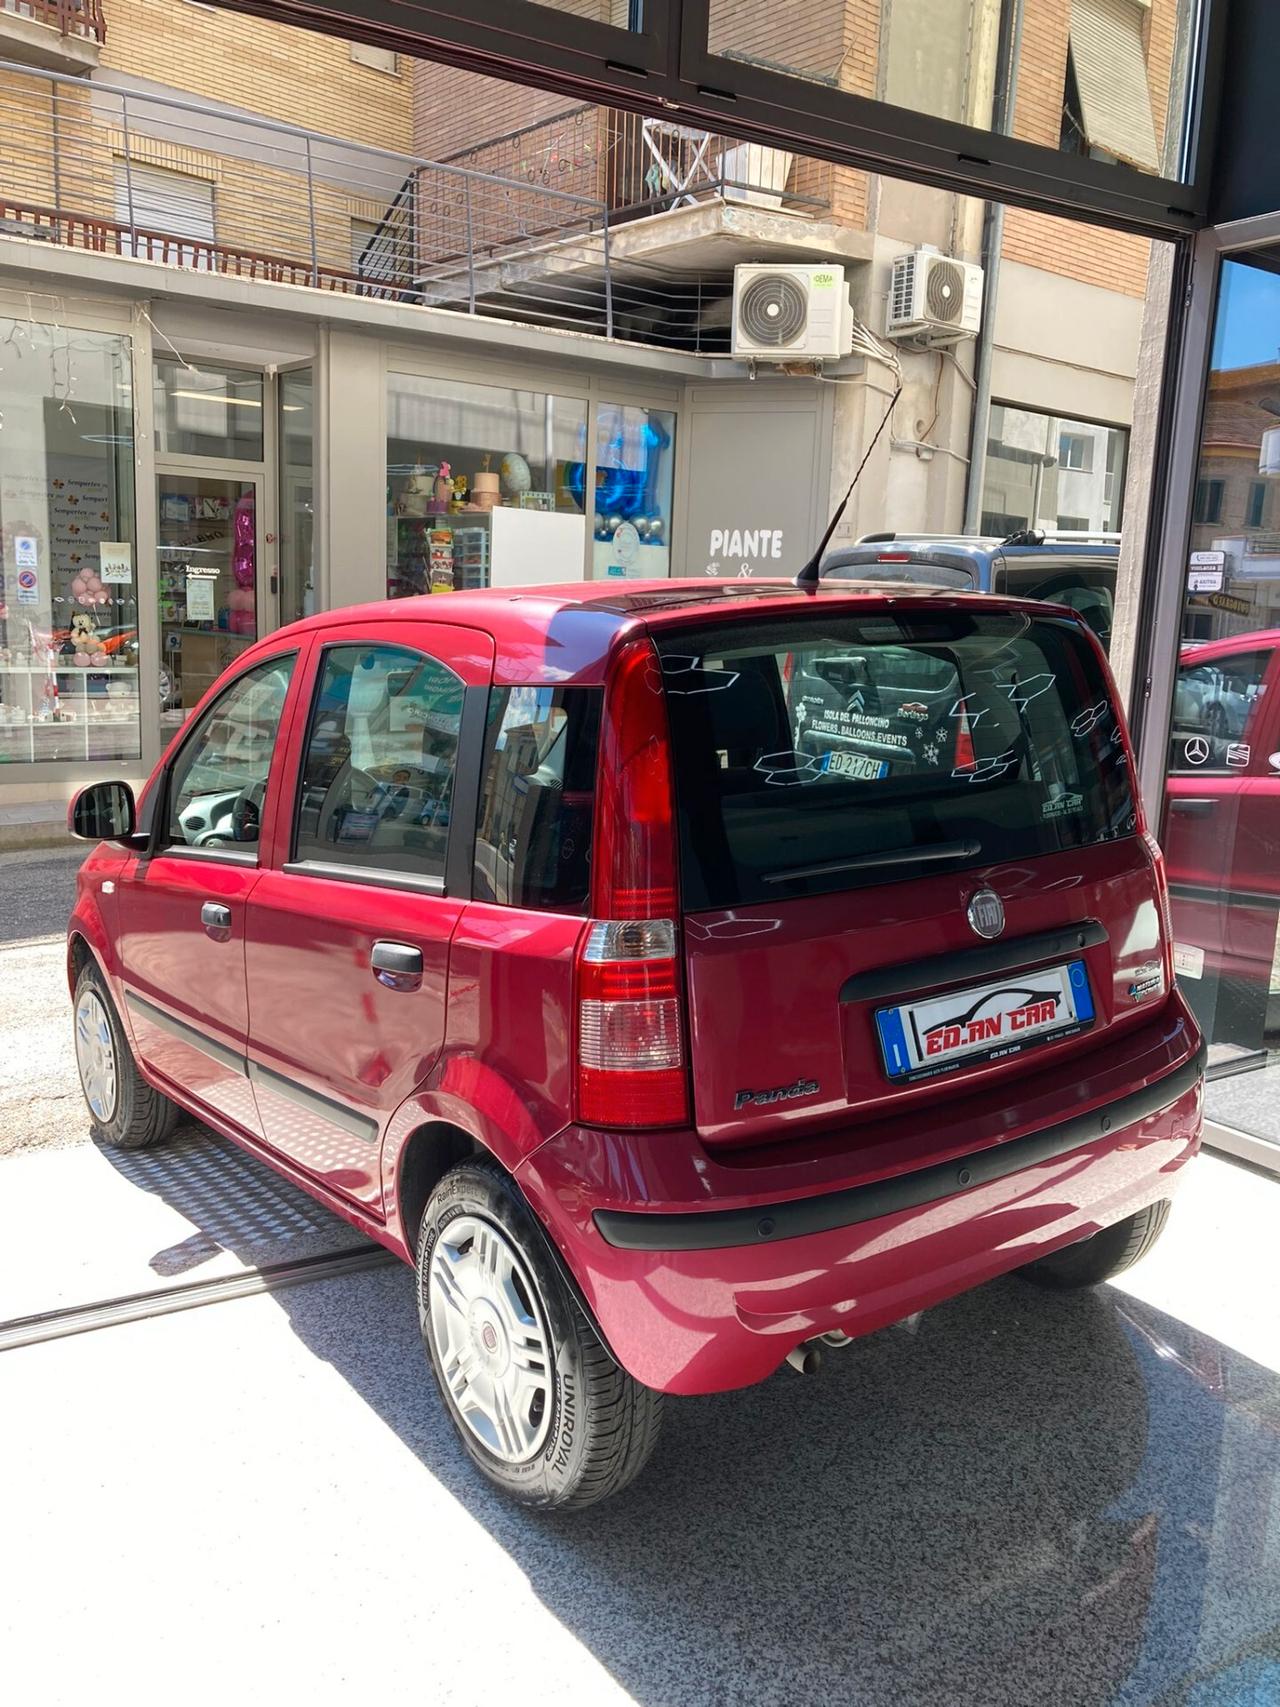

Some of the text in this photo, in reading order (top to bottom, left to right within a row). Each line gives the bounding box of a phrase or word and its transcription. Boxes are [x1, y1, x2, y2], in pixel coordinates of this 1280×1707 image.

[710, 529, 783, 558] PIANTE
[185, 565, 221, 575] Ingresso
[737, 562, 754, 578] &
[824, 709, 890, 728] ISOLA DEL PALLONCINO
[976, 901, 999, 929] FIAT
[926, 999, 1057, 1056] ED.AN CAR
[733, 1079, 820, 1111] Panda
[425, 1231, 436, 1255] TYRE
[422, 1258, 431, 1281] RAIN
[552, 1374, 575, 1475] UNIROYAL
